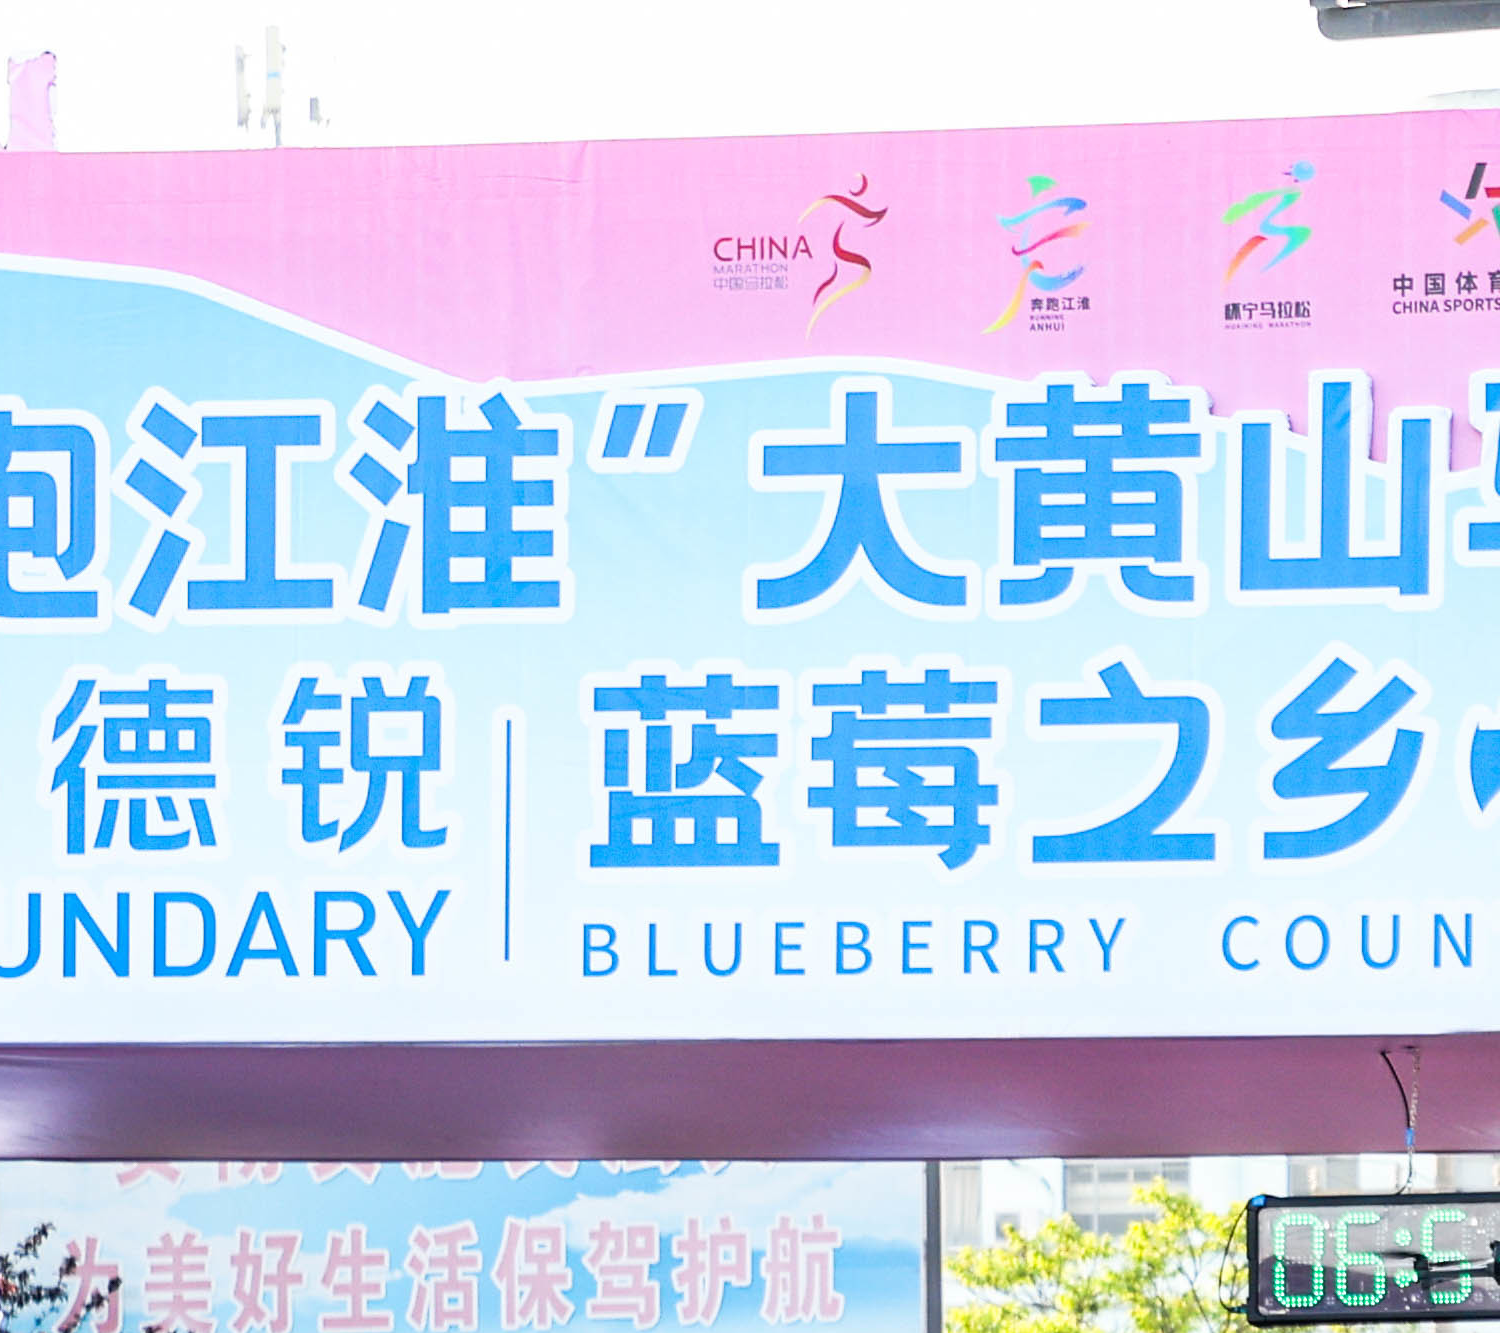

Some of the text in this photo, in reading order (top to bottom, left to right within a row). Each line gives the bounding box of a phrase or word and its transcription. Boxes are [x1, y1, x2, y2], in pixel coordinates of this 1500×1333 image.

[713, 236, 812, 261] CHINA
[713, 264, 788, 275] MARATHON
[1030, 297, 1090, 312] 奔跑江淮
[1393, 300, 1439, 314] CHINA
[1030, 322, 1064, 332] ANHUI
[581, 915, 1130, 978] BLUEBERRY
